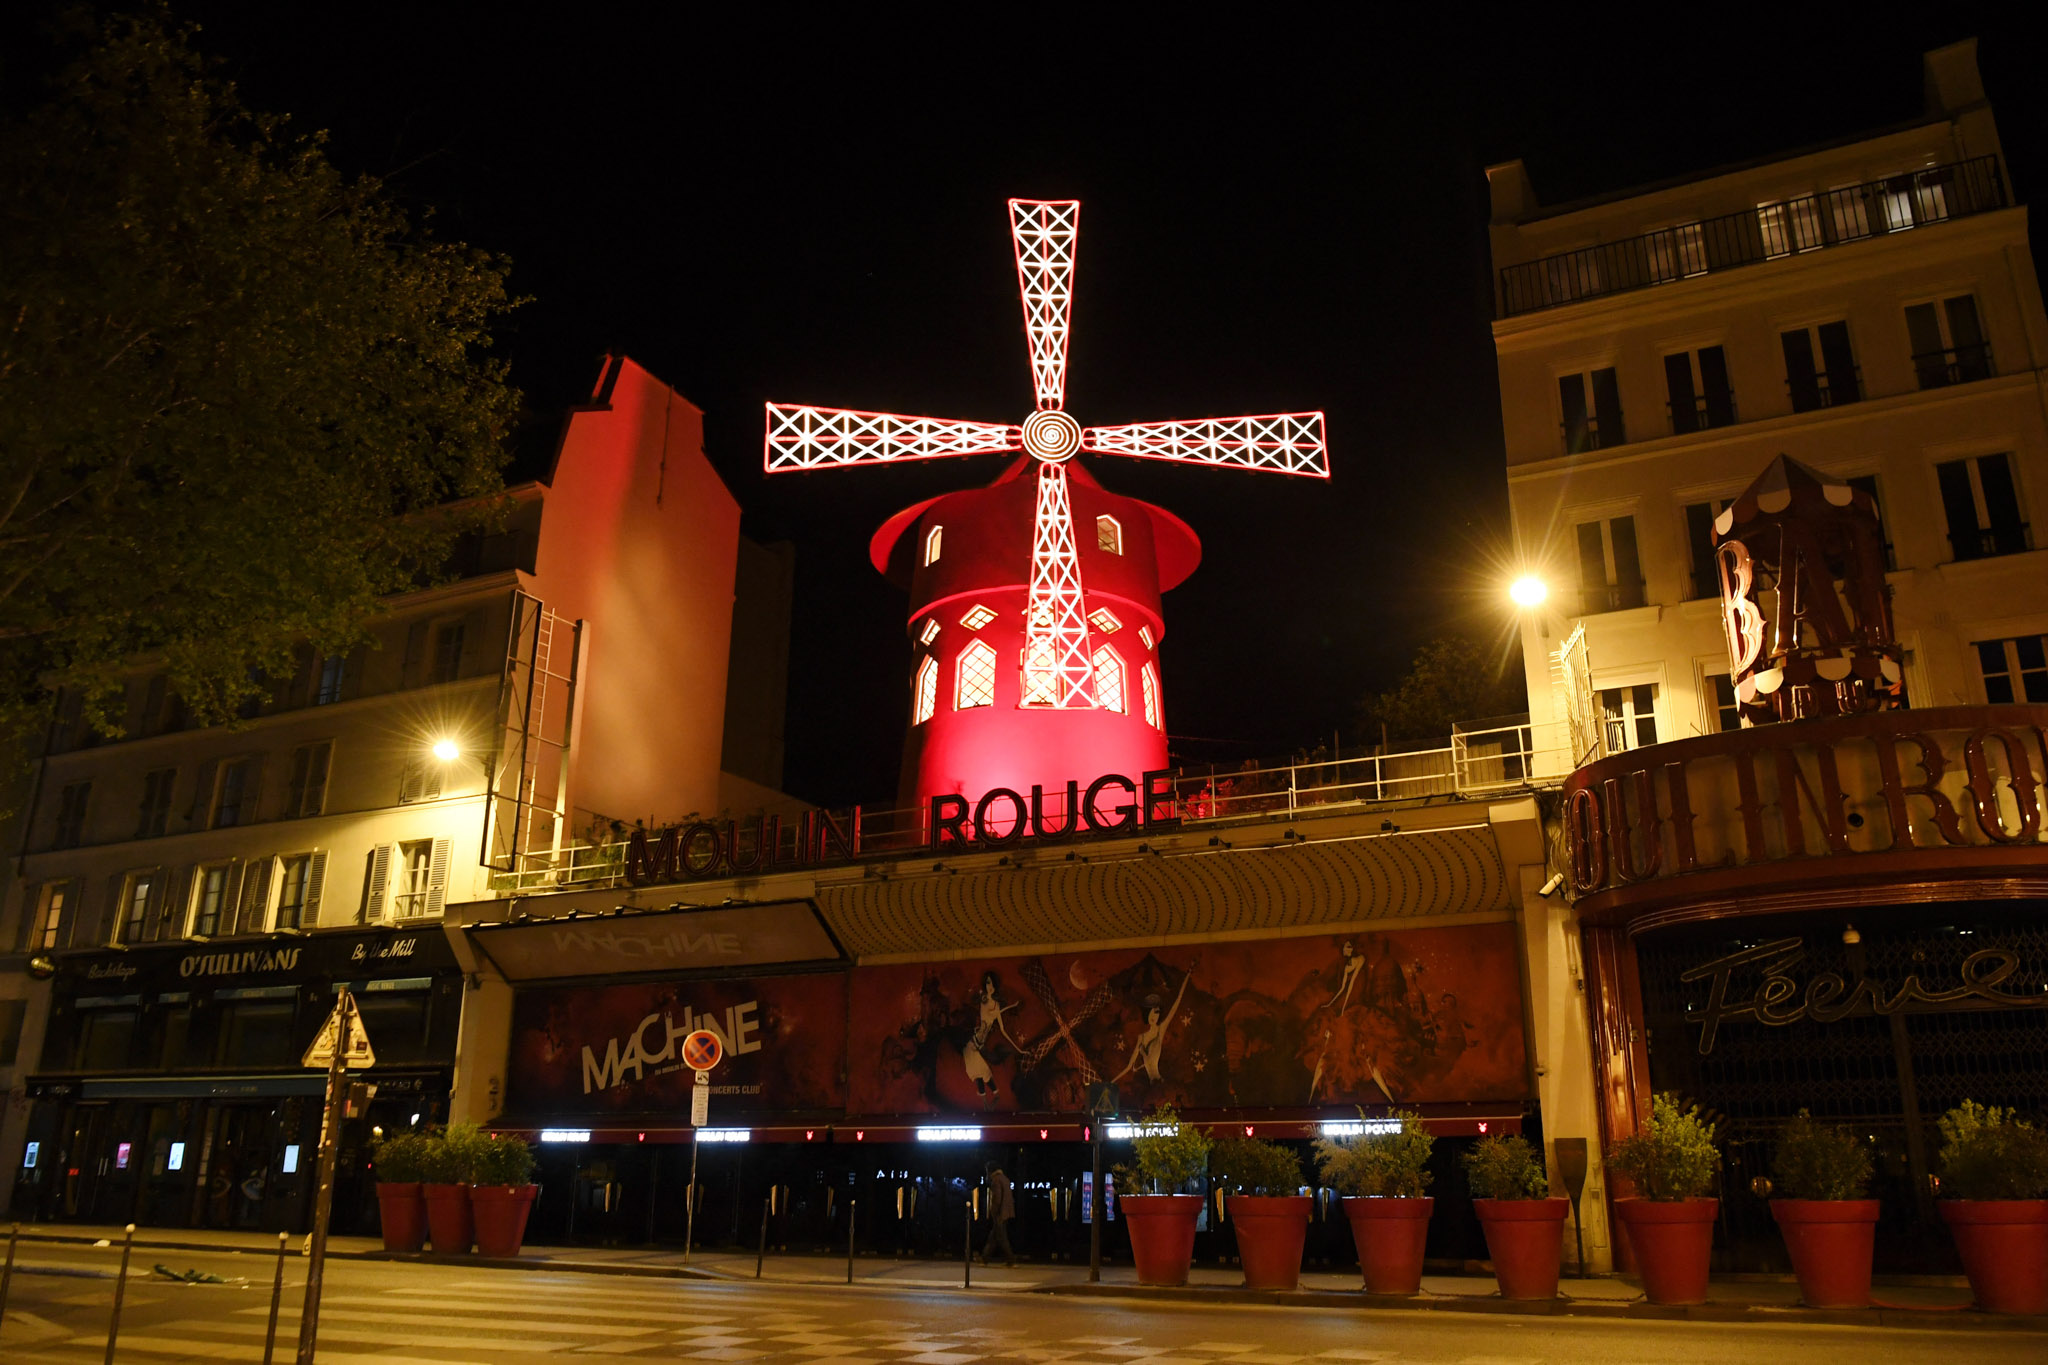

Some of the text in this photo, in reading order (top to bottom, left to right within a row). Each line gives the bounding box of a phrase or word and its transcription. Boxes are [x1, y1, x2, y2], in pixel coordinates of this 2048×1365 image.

[627, 767, 1183, 884] MOULIN ROUGE
[1563, 726, 2048, 894] OULIN RO
[179, 947, 302, 978] O'SULLIVANS
[351, 943, 367, 966] By
[388, 938, 416, 958] Mill
[709, 1085, 740, 1094] ONCERTS
